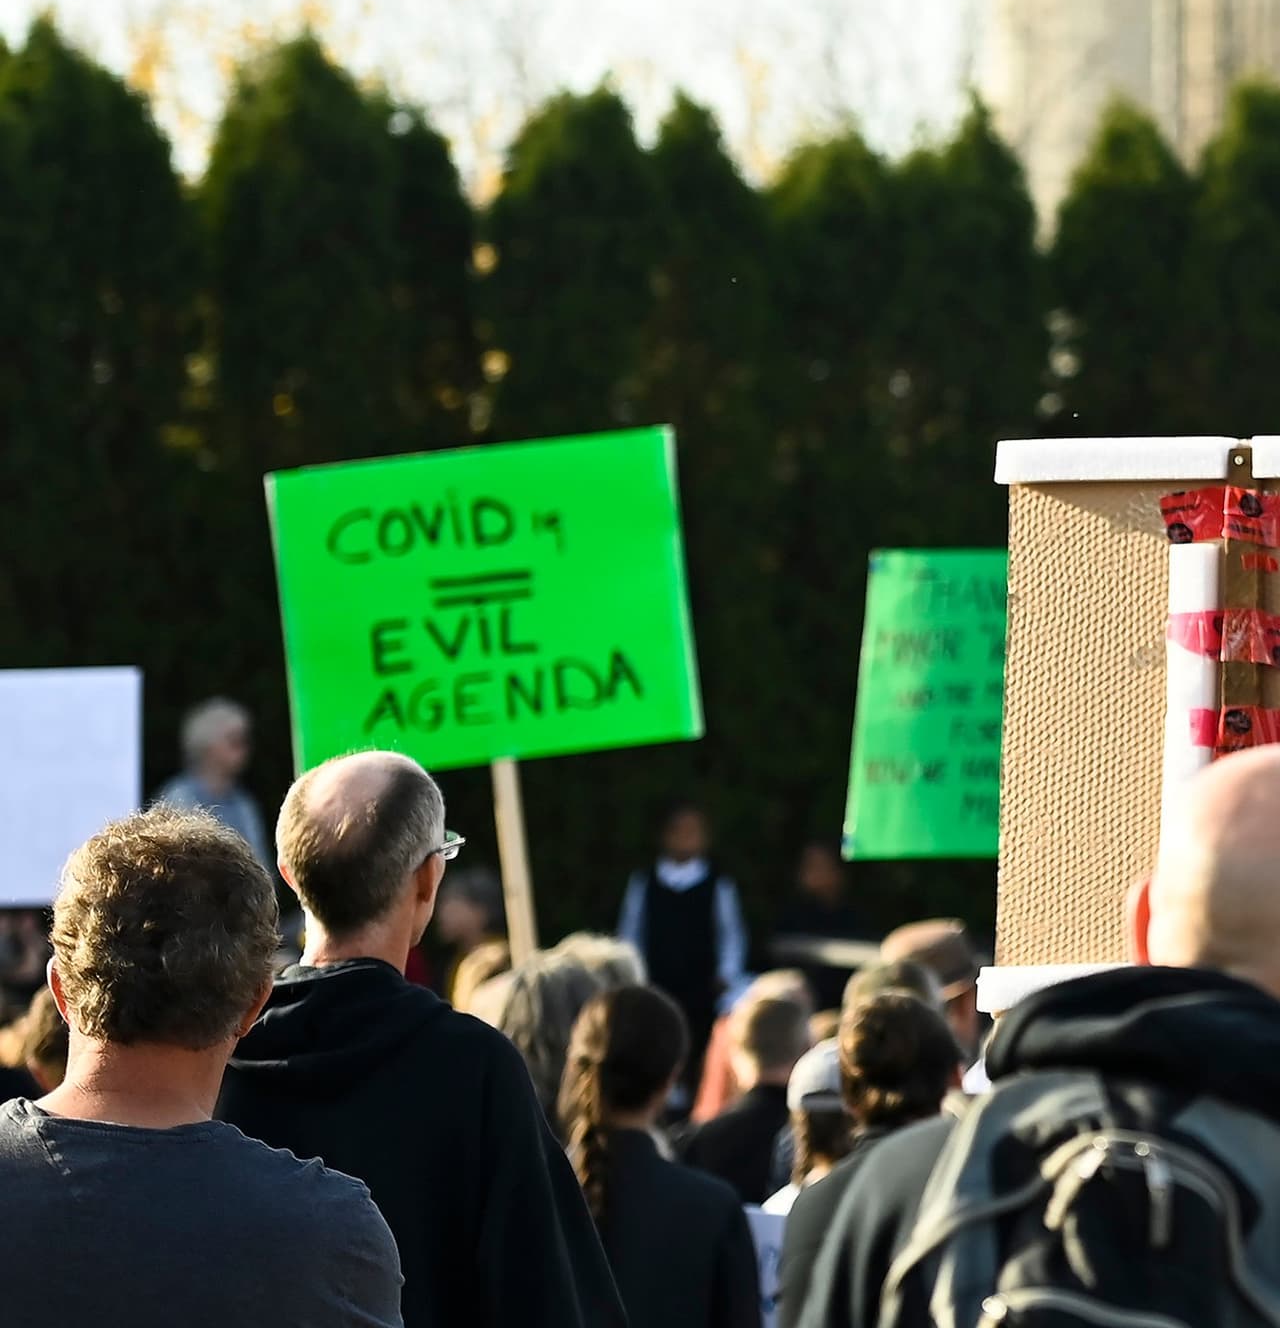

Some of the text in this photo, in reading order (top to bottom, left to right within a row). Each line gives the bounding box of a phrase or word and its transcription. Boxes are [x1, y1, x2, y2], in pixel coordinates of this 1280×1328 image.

[326, 490, 514, 564] COVID
[370, 604, 539, 677] EVIL
[362, 646, 645, 736] AGENDA
